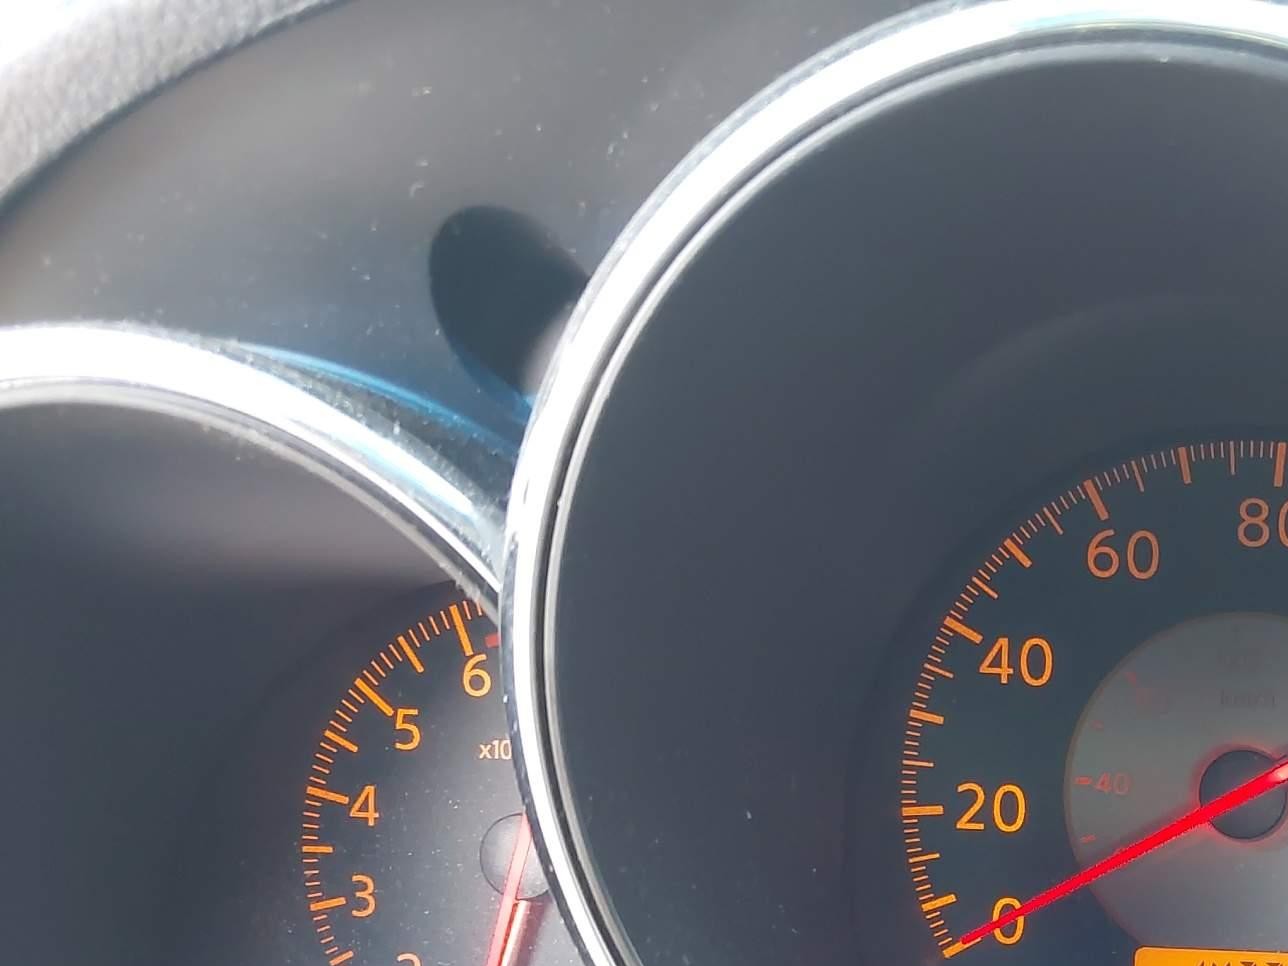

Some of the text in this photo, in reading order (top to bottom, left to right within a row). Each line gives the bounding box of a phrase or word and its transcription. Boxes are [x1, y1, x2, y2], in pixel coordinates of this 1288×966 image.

[1086, 529, 1161, 580] 60
[463, 653, 492, 697] 6
[979, 636, 1055, 688] 40
[394, 707, 420, 750] 5
[348, 785, 380, 827] 4
[955, 783, 1027, 833] 20
[351, 874, 377, 918] 3
[991, 897, 1024, 945] 0
